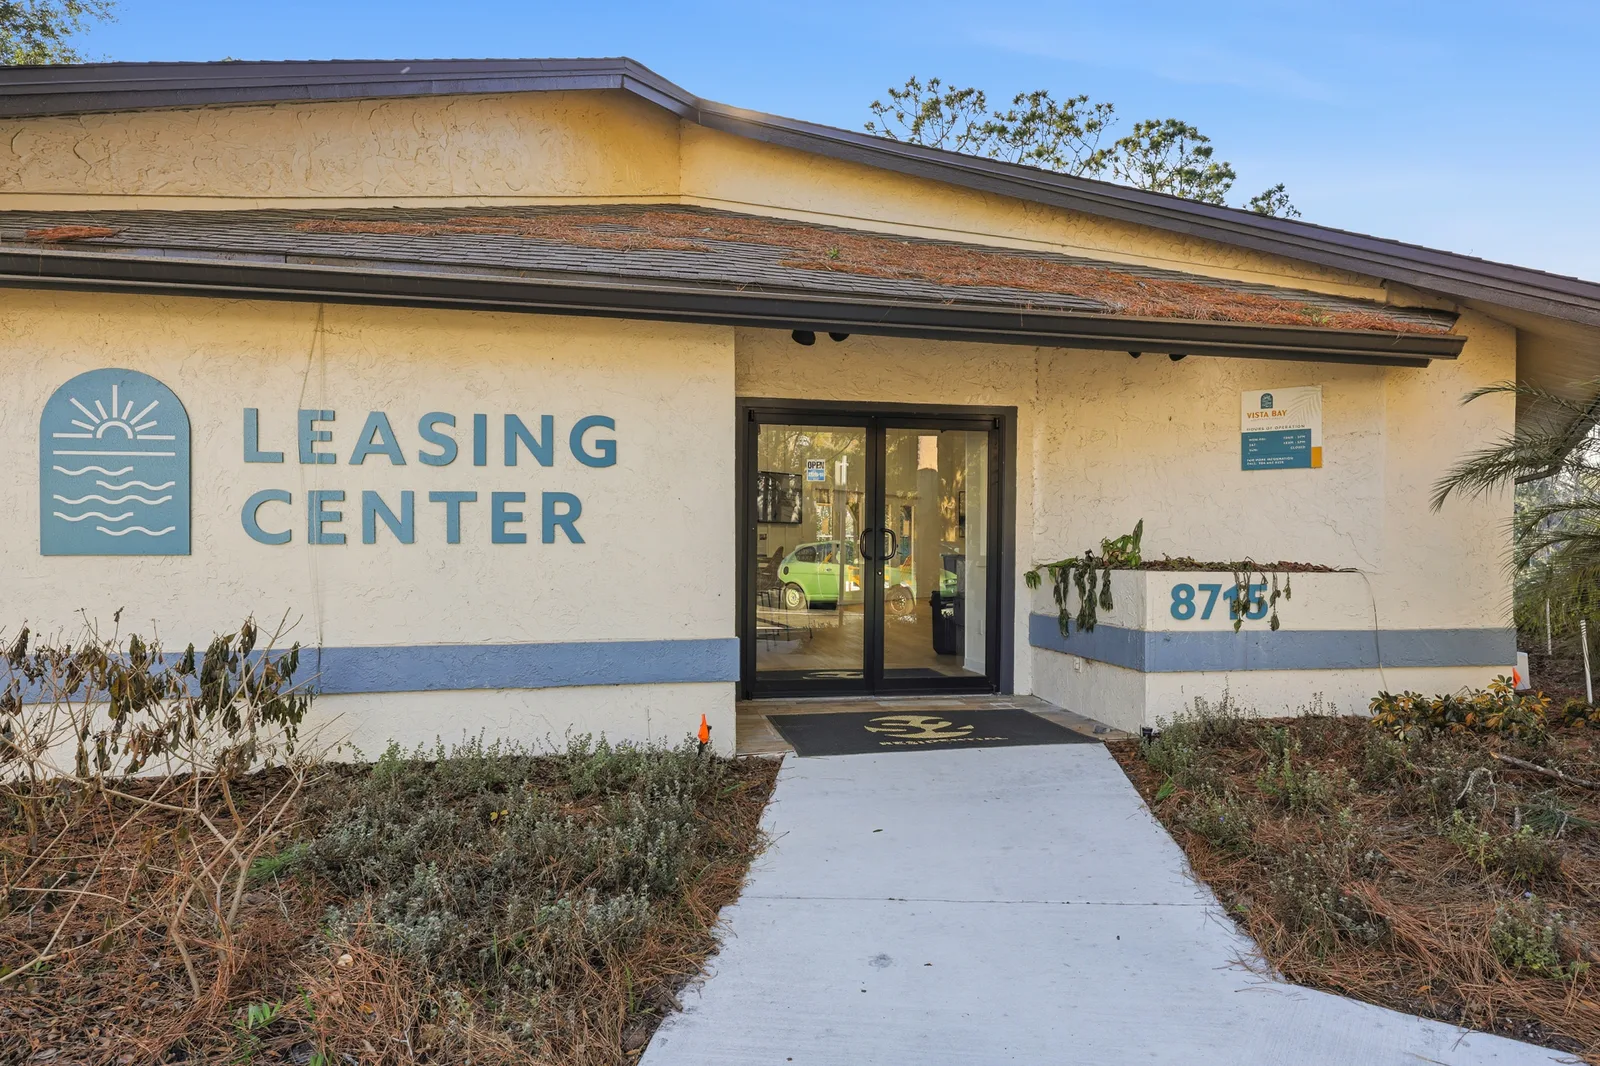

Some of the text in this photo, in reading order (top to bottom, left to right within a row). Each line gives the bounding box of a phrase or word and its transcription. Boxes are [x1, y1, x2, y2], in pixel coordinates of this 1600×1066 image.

[1246, 409, 1288, 419] VISTA BAY
[243, 407, 617, 468] LEASING
[807, 461, 825, 469] OPEN
[240, 489, 586, 546] CENTER
[1170, 583, 1269, 621] 8715
